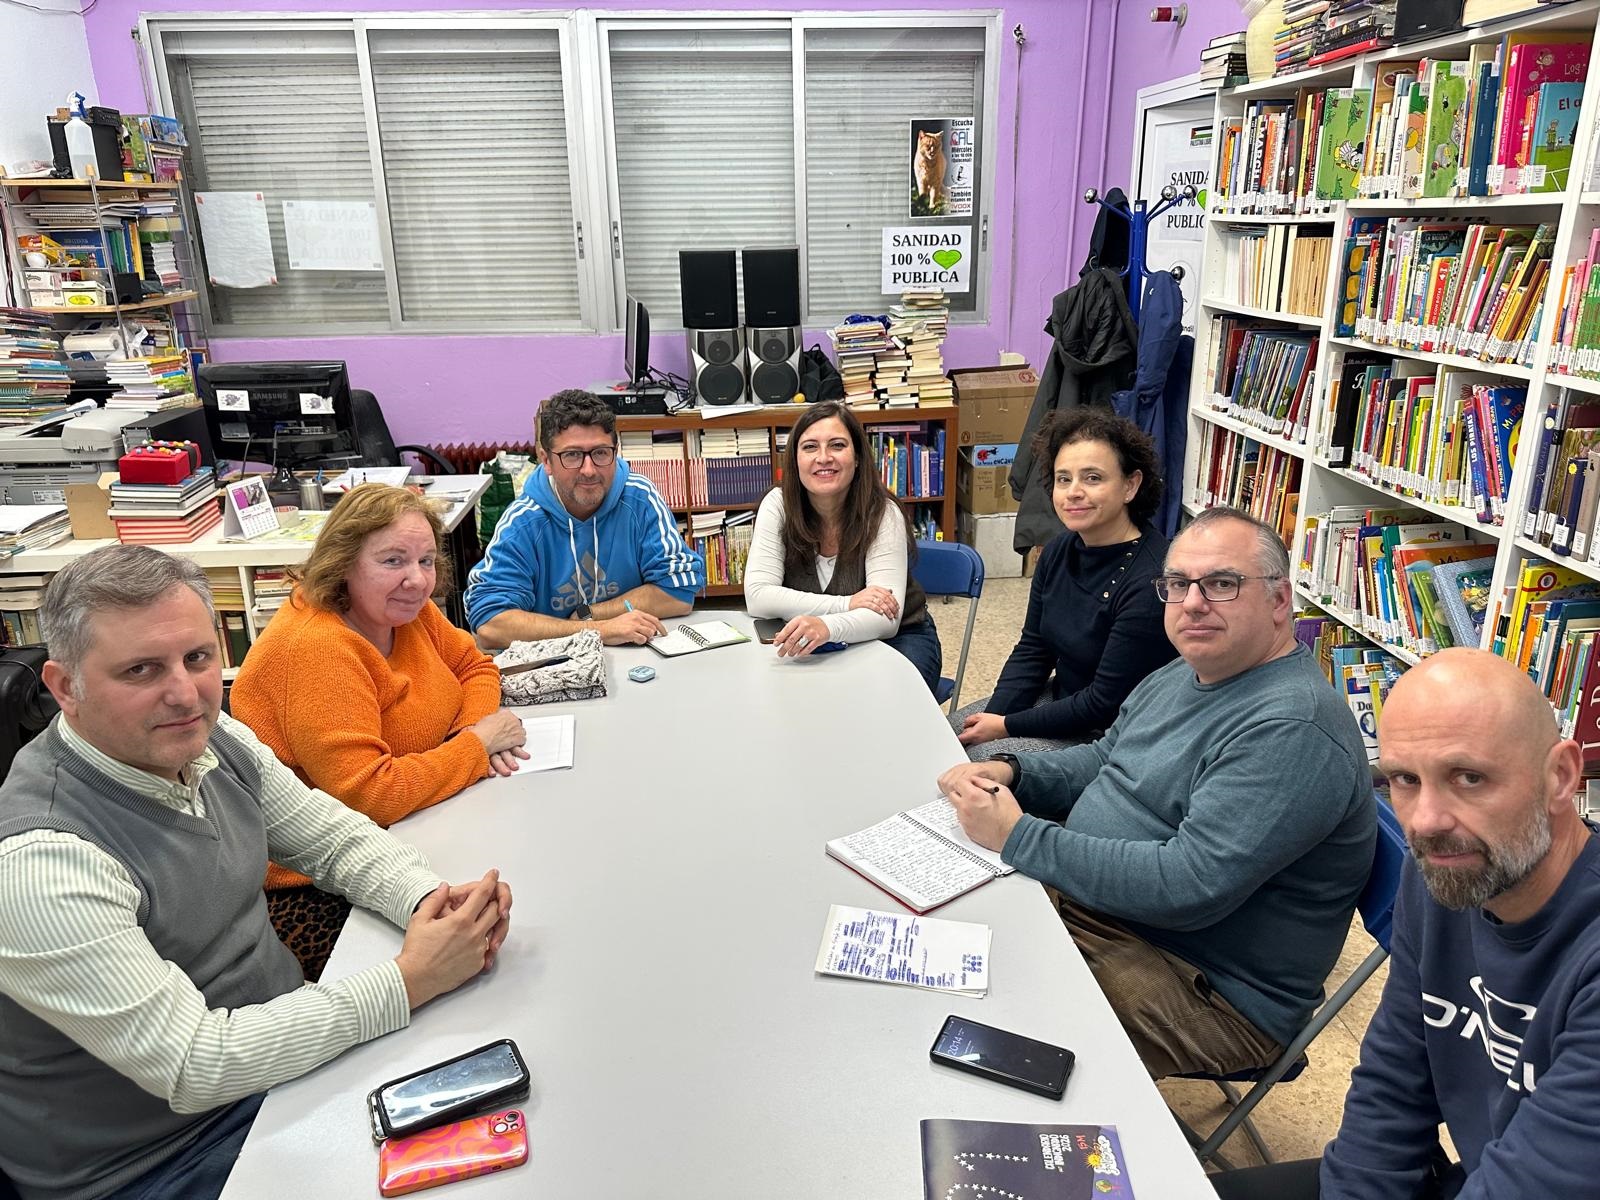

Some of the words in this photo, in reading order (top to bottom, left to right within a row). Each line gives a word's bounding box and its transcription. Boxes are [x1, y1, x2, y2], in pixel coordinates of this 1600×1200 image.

[951, 119, 973, 127] Escucha
[1254, 123, 1267, 180] MARCH
[892, 234, 962, 247] SANIDAD
[890, 253, 913, 266] 100
[917, 253, 931, 265] %
[892, 271, 960, 284] PUBLICA
[252, 392, 289, 400] SAMSUNG
[1470, 446, 1478, 463] LOS
[1060, 1134, 1072, 1152] 2026
